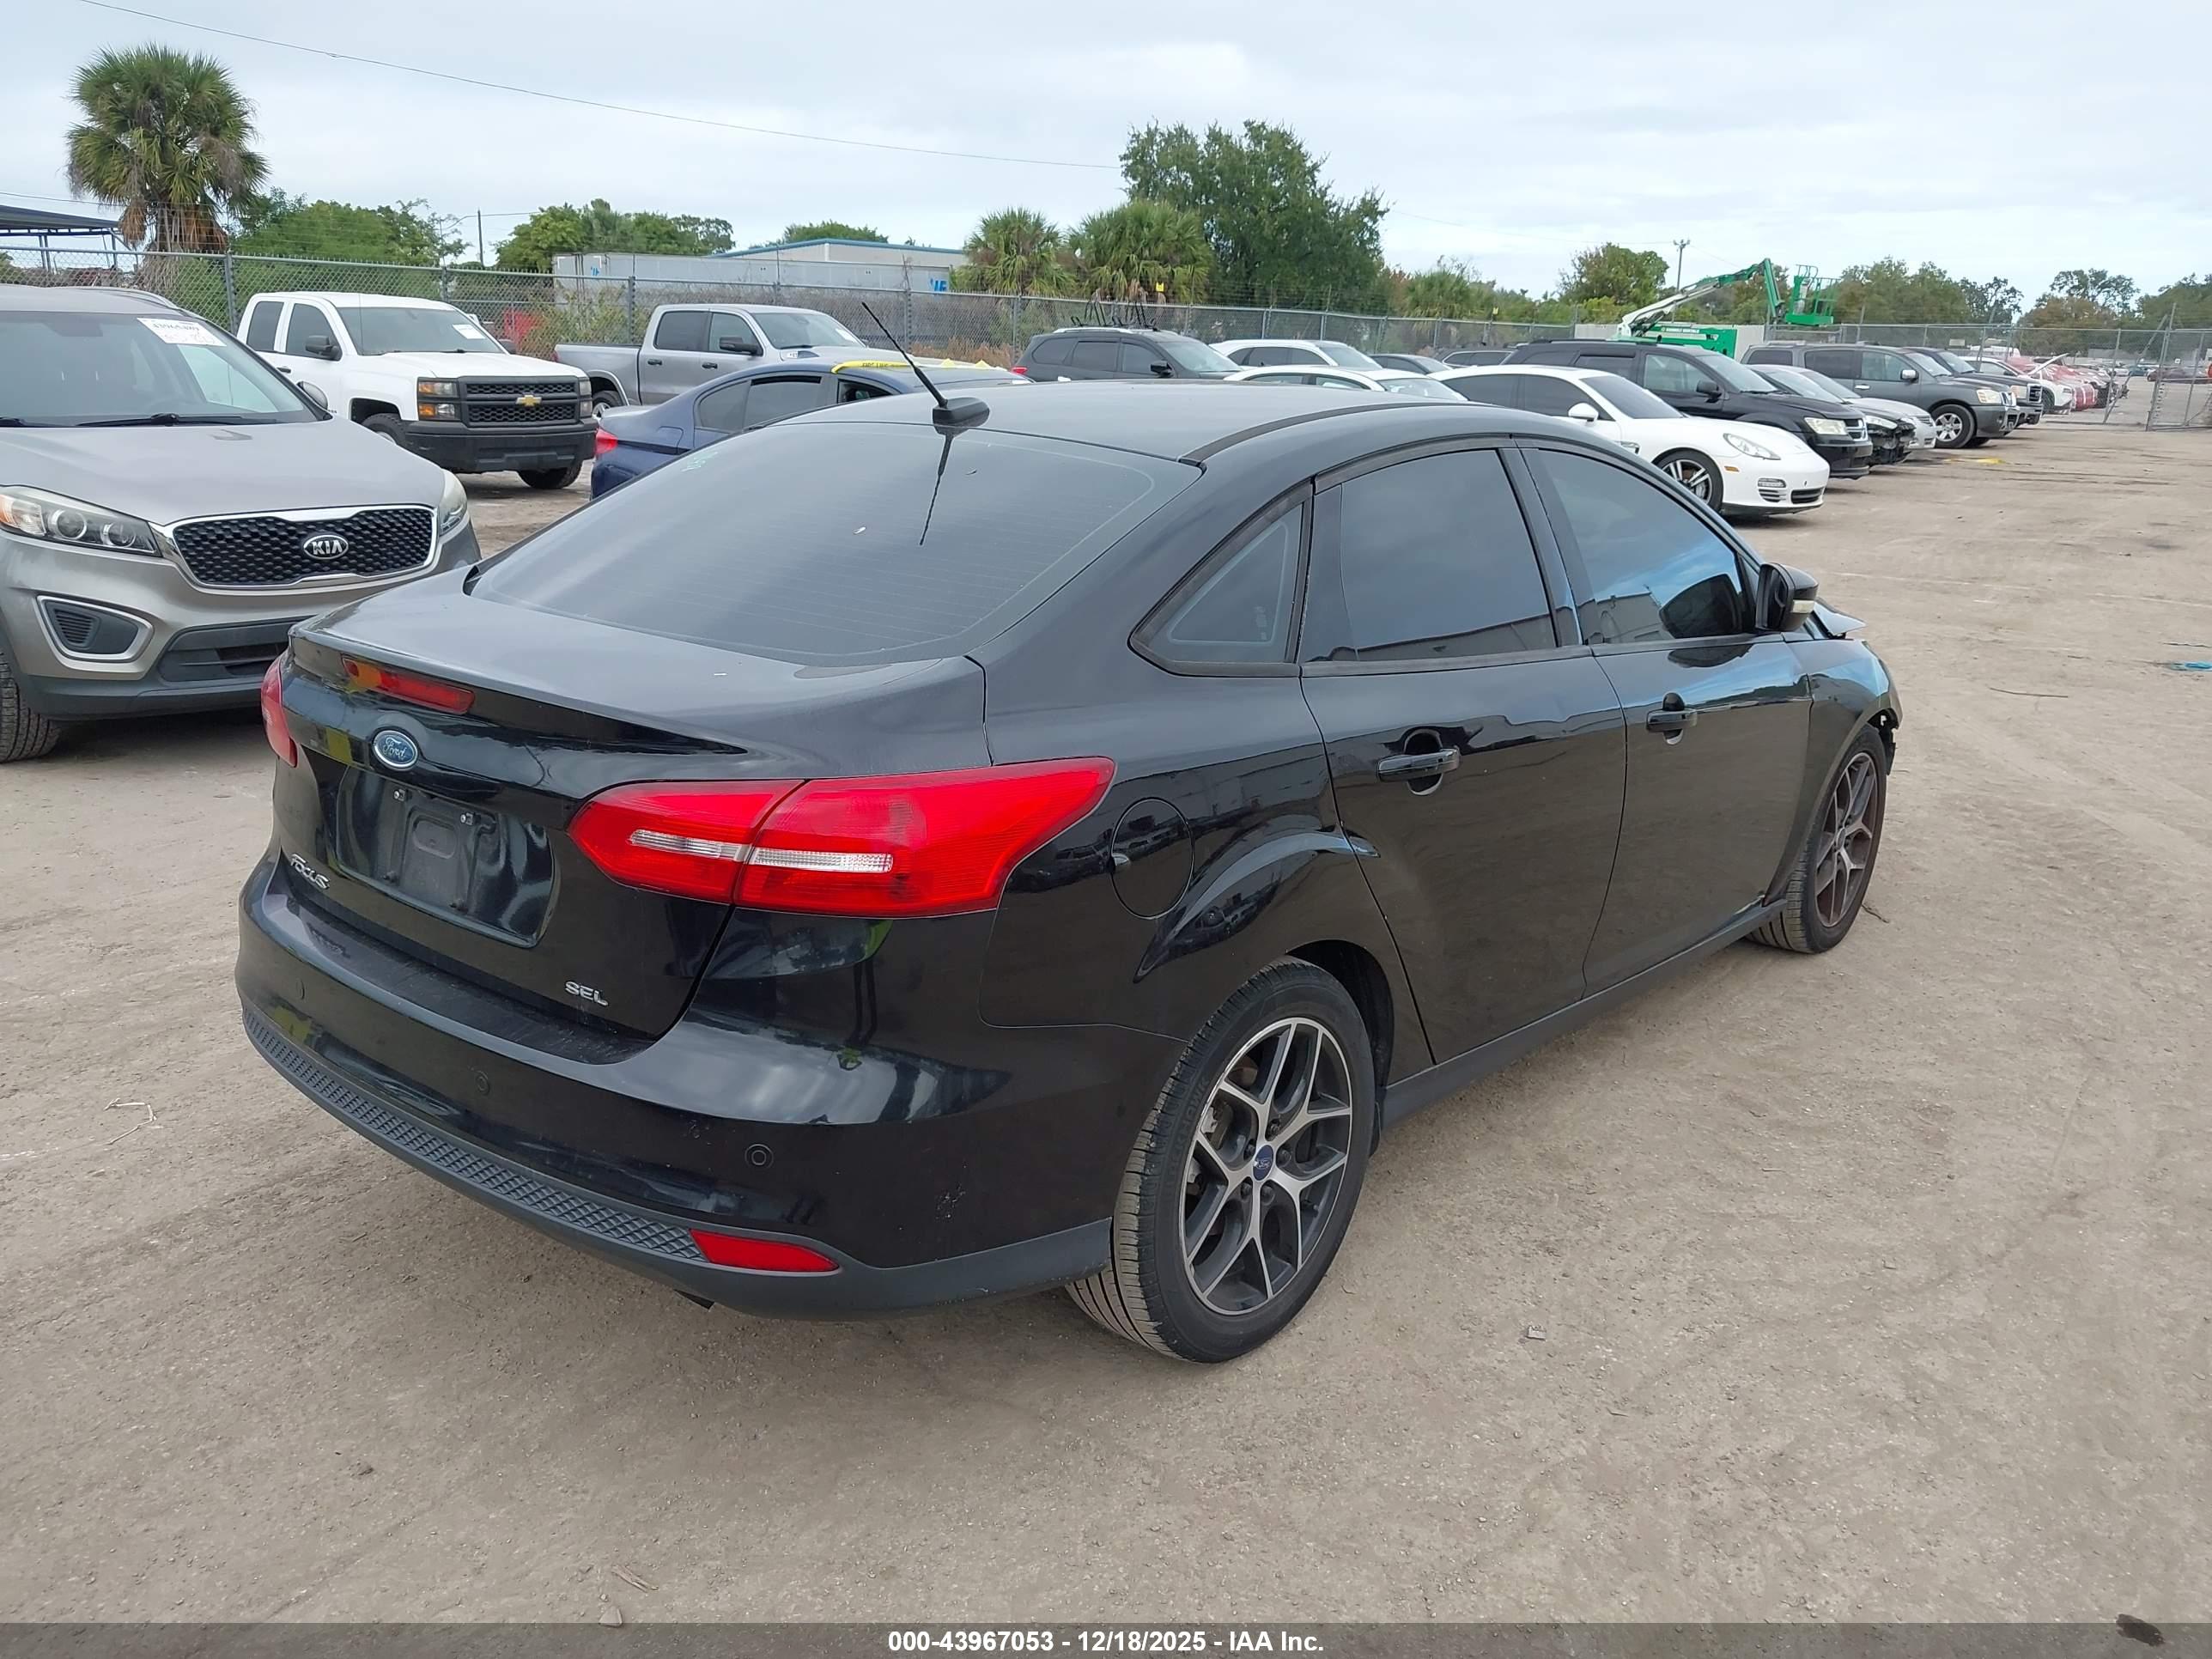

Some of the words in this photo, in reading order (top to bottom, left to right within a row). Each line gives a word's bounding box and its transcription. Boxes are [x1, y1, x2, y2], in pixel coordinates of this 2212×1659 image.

[312, 539, 343, 556] KIA
[382, 737, 408, 761] Ford
[564, 981, 609, 1006] SEL
